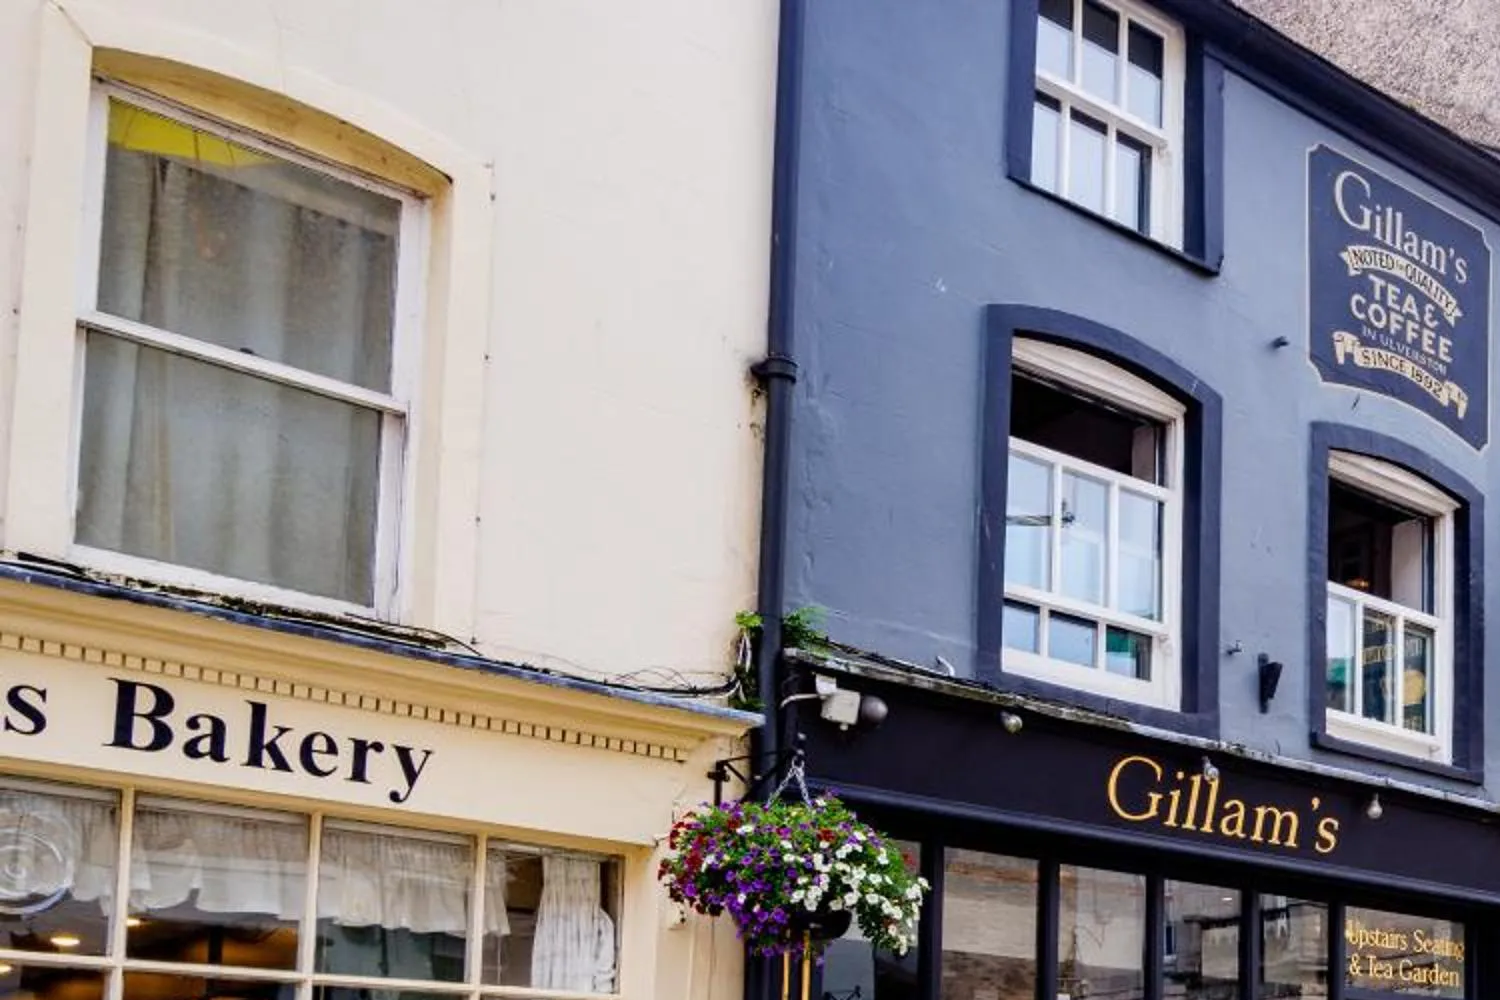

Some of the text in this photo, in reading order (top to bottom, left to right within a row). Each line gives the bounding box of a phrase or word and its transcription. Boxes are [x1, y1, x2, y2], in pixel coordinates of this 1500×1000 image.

[1335, 171, 1468, 284] Gillam's
[1350, 249, 1395, 271] NOTED
[1368, 273, 1440, 329] TEA &
[1351, 293, 1453, 363] COFFEE
[1362, 325, 1448, 376] IN ULVERSTON
[1361, 349, 1407, 373] SINCE
[103, 676, 434, 804] Bakery
[1107, 754, 1341, 854] Gillam's
[1344, 919, 1465, 963] Upstairs Seating
[1349, 953, 1460, 988] & Tea Garden
